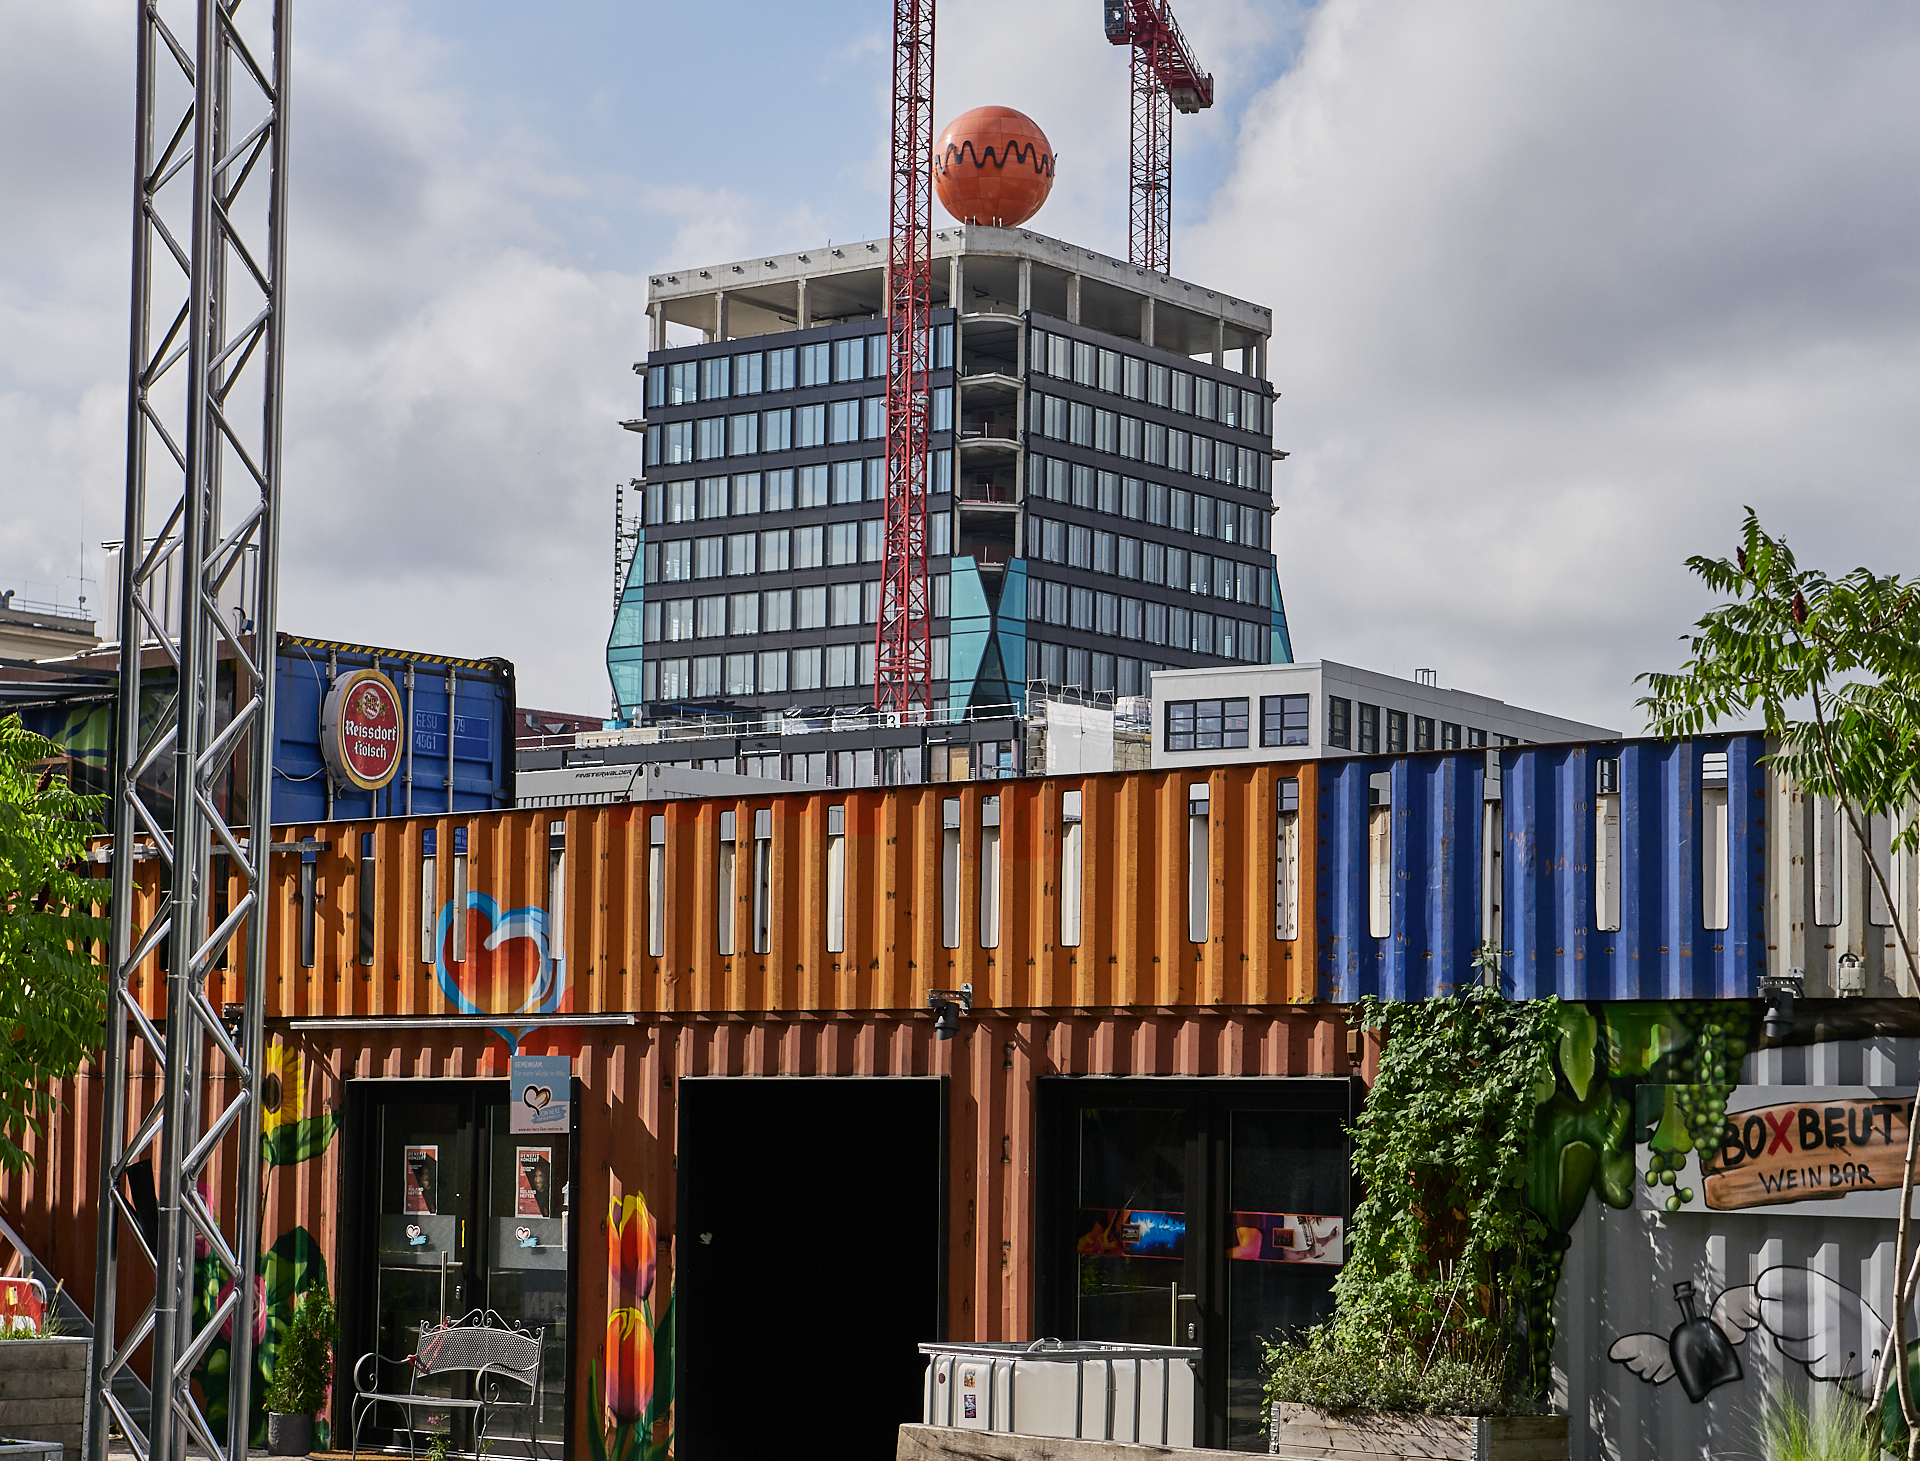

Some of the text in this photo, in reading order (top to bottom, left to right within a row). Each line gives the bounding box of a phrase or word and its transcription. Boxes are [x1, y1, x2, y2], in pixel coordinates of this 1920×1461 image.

[345, 720, 397, 741] Reissdorf
[416, 713, 438, 729] GESU
[354, 741, 386, 761] Kölsch
[416, 734, 436, 750] 45G1
[1721, 1103, 1915, 1166] BOXBEUT
[1758, 1161, 1876, 1194] WEIN BAR
